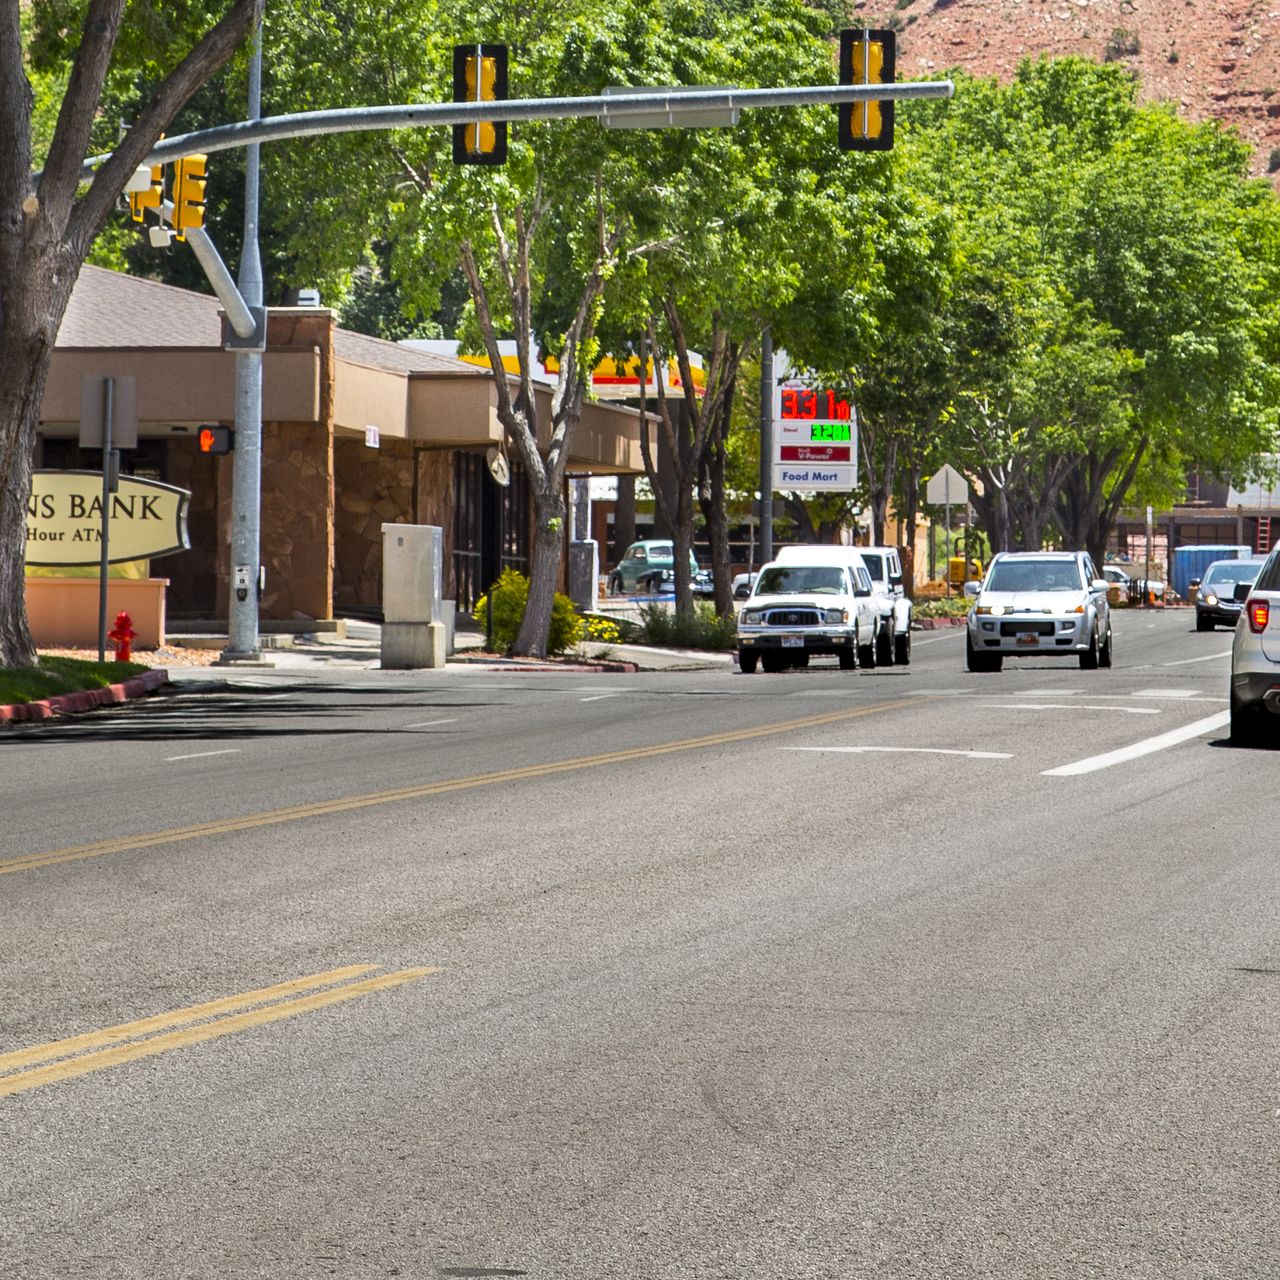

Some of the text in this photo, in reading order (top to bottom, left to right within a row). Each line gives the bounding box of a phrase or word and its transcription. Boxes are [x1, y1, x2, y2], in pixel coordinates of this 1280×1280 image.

[782, 472, 838, 481] Food Mart
[69, 494, 163, 520] BANK
[26, 528, 65, 541] Hour
